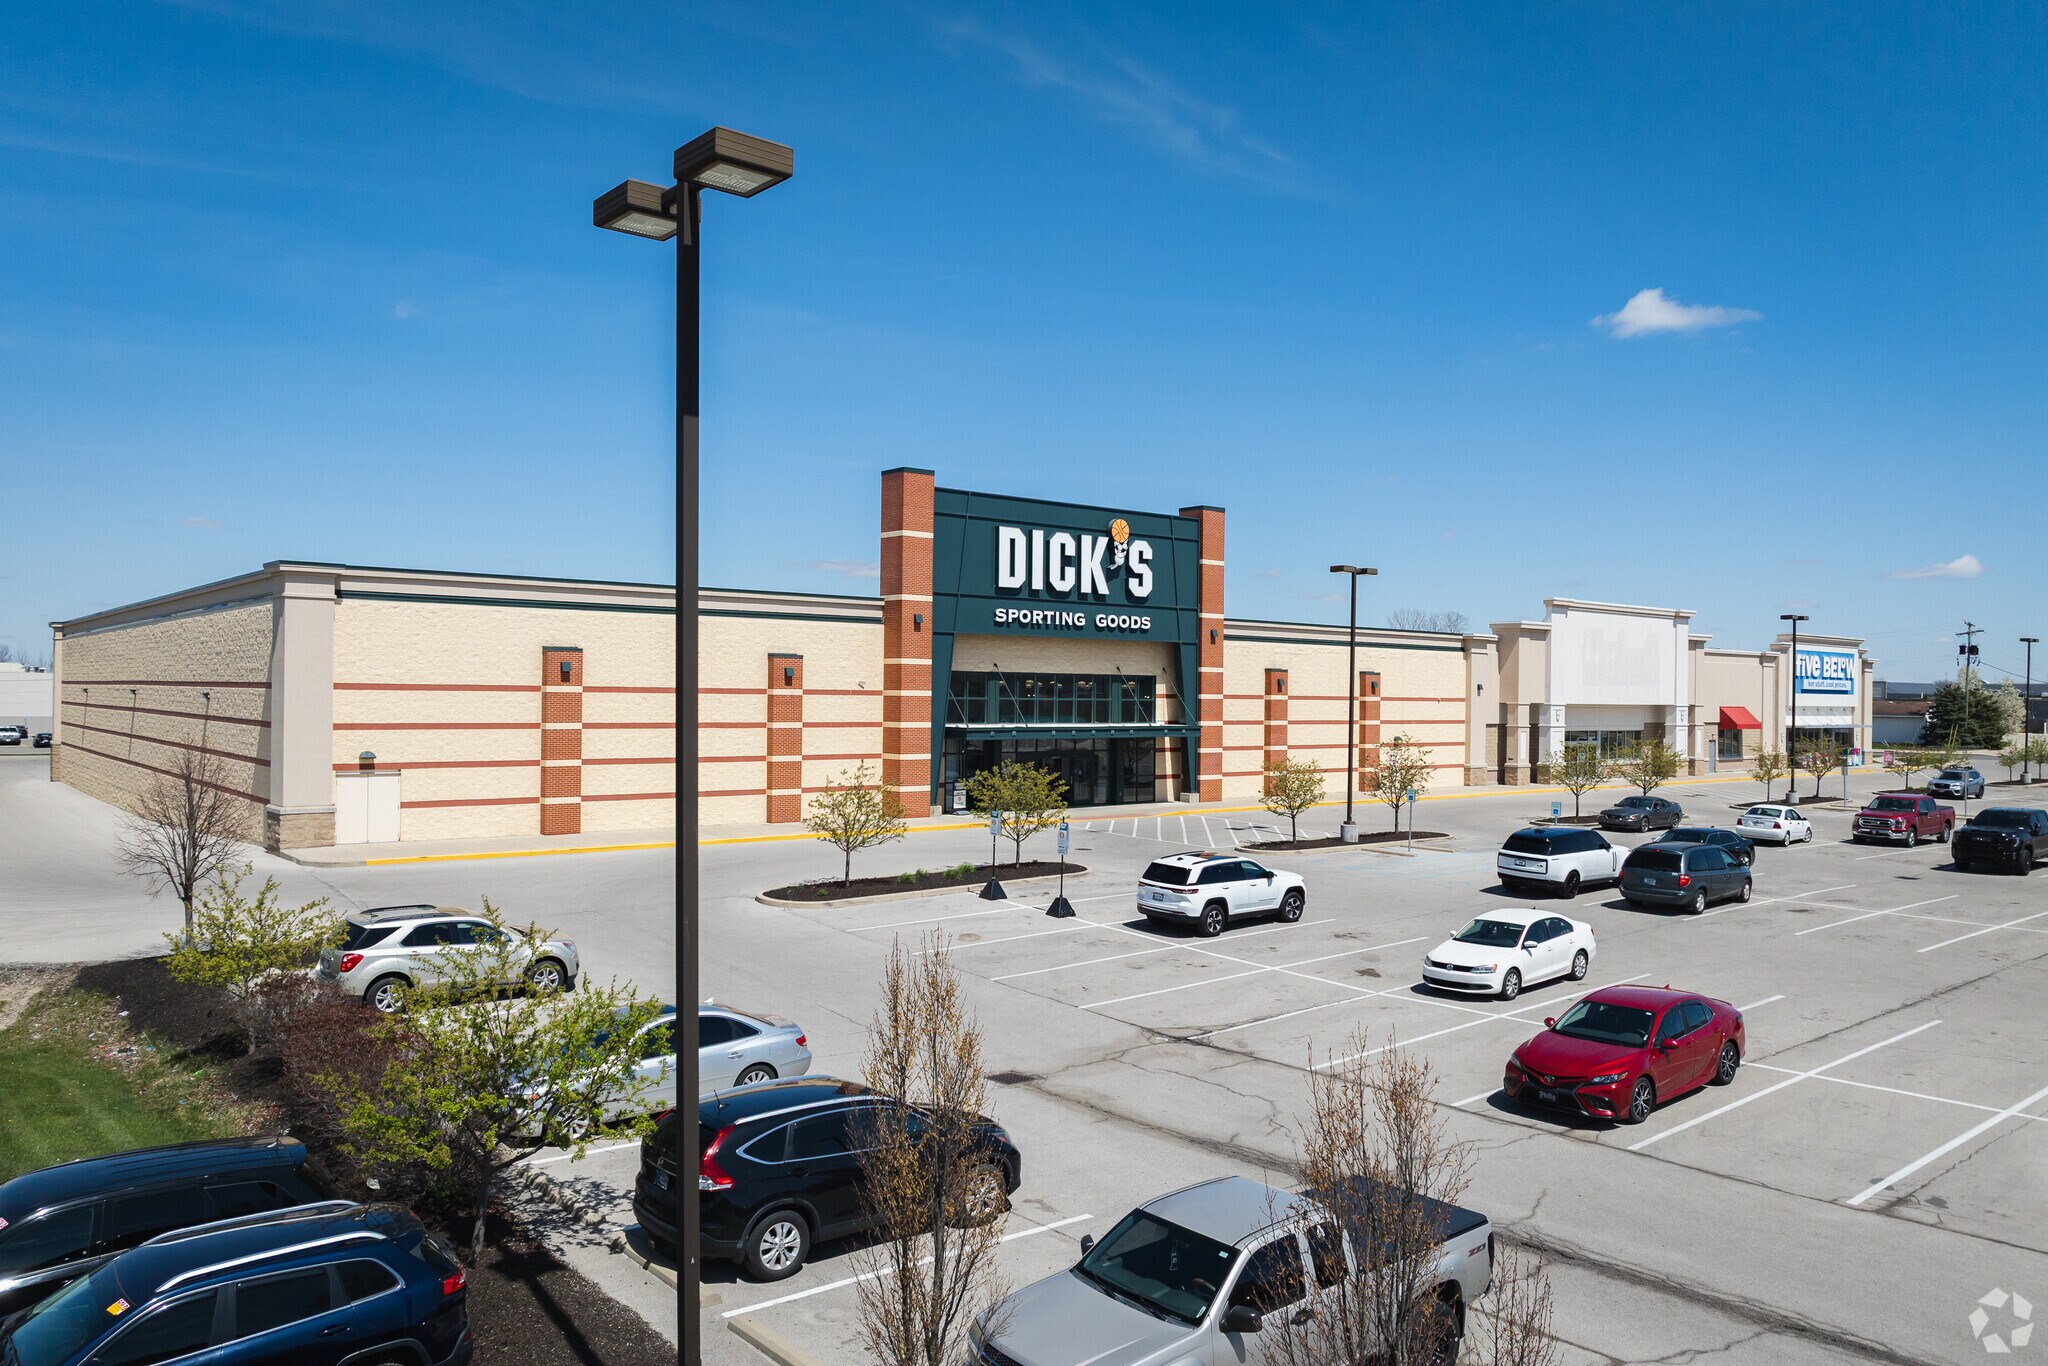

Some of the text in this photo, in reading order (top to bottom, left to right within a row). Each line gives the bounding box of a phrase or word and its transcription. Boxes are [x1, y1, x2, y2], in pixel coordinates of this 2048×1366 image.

[999, 519, 1153, 598] DICK'S
[995, 608, 1152, 630] SPORTING GOODS
[1823, 656, 1854, 678] BELOW
